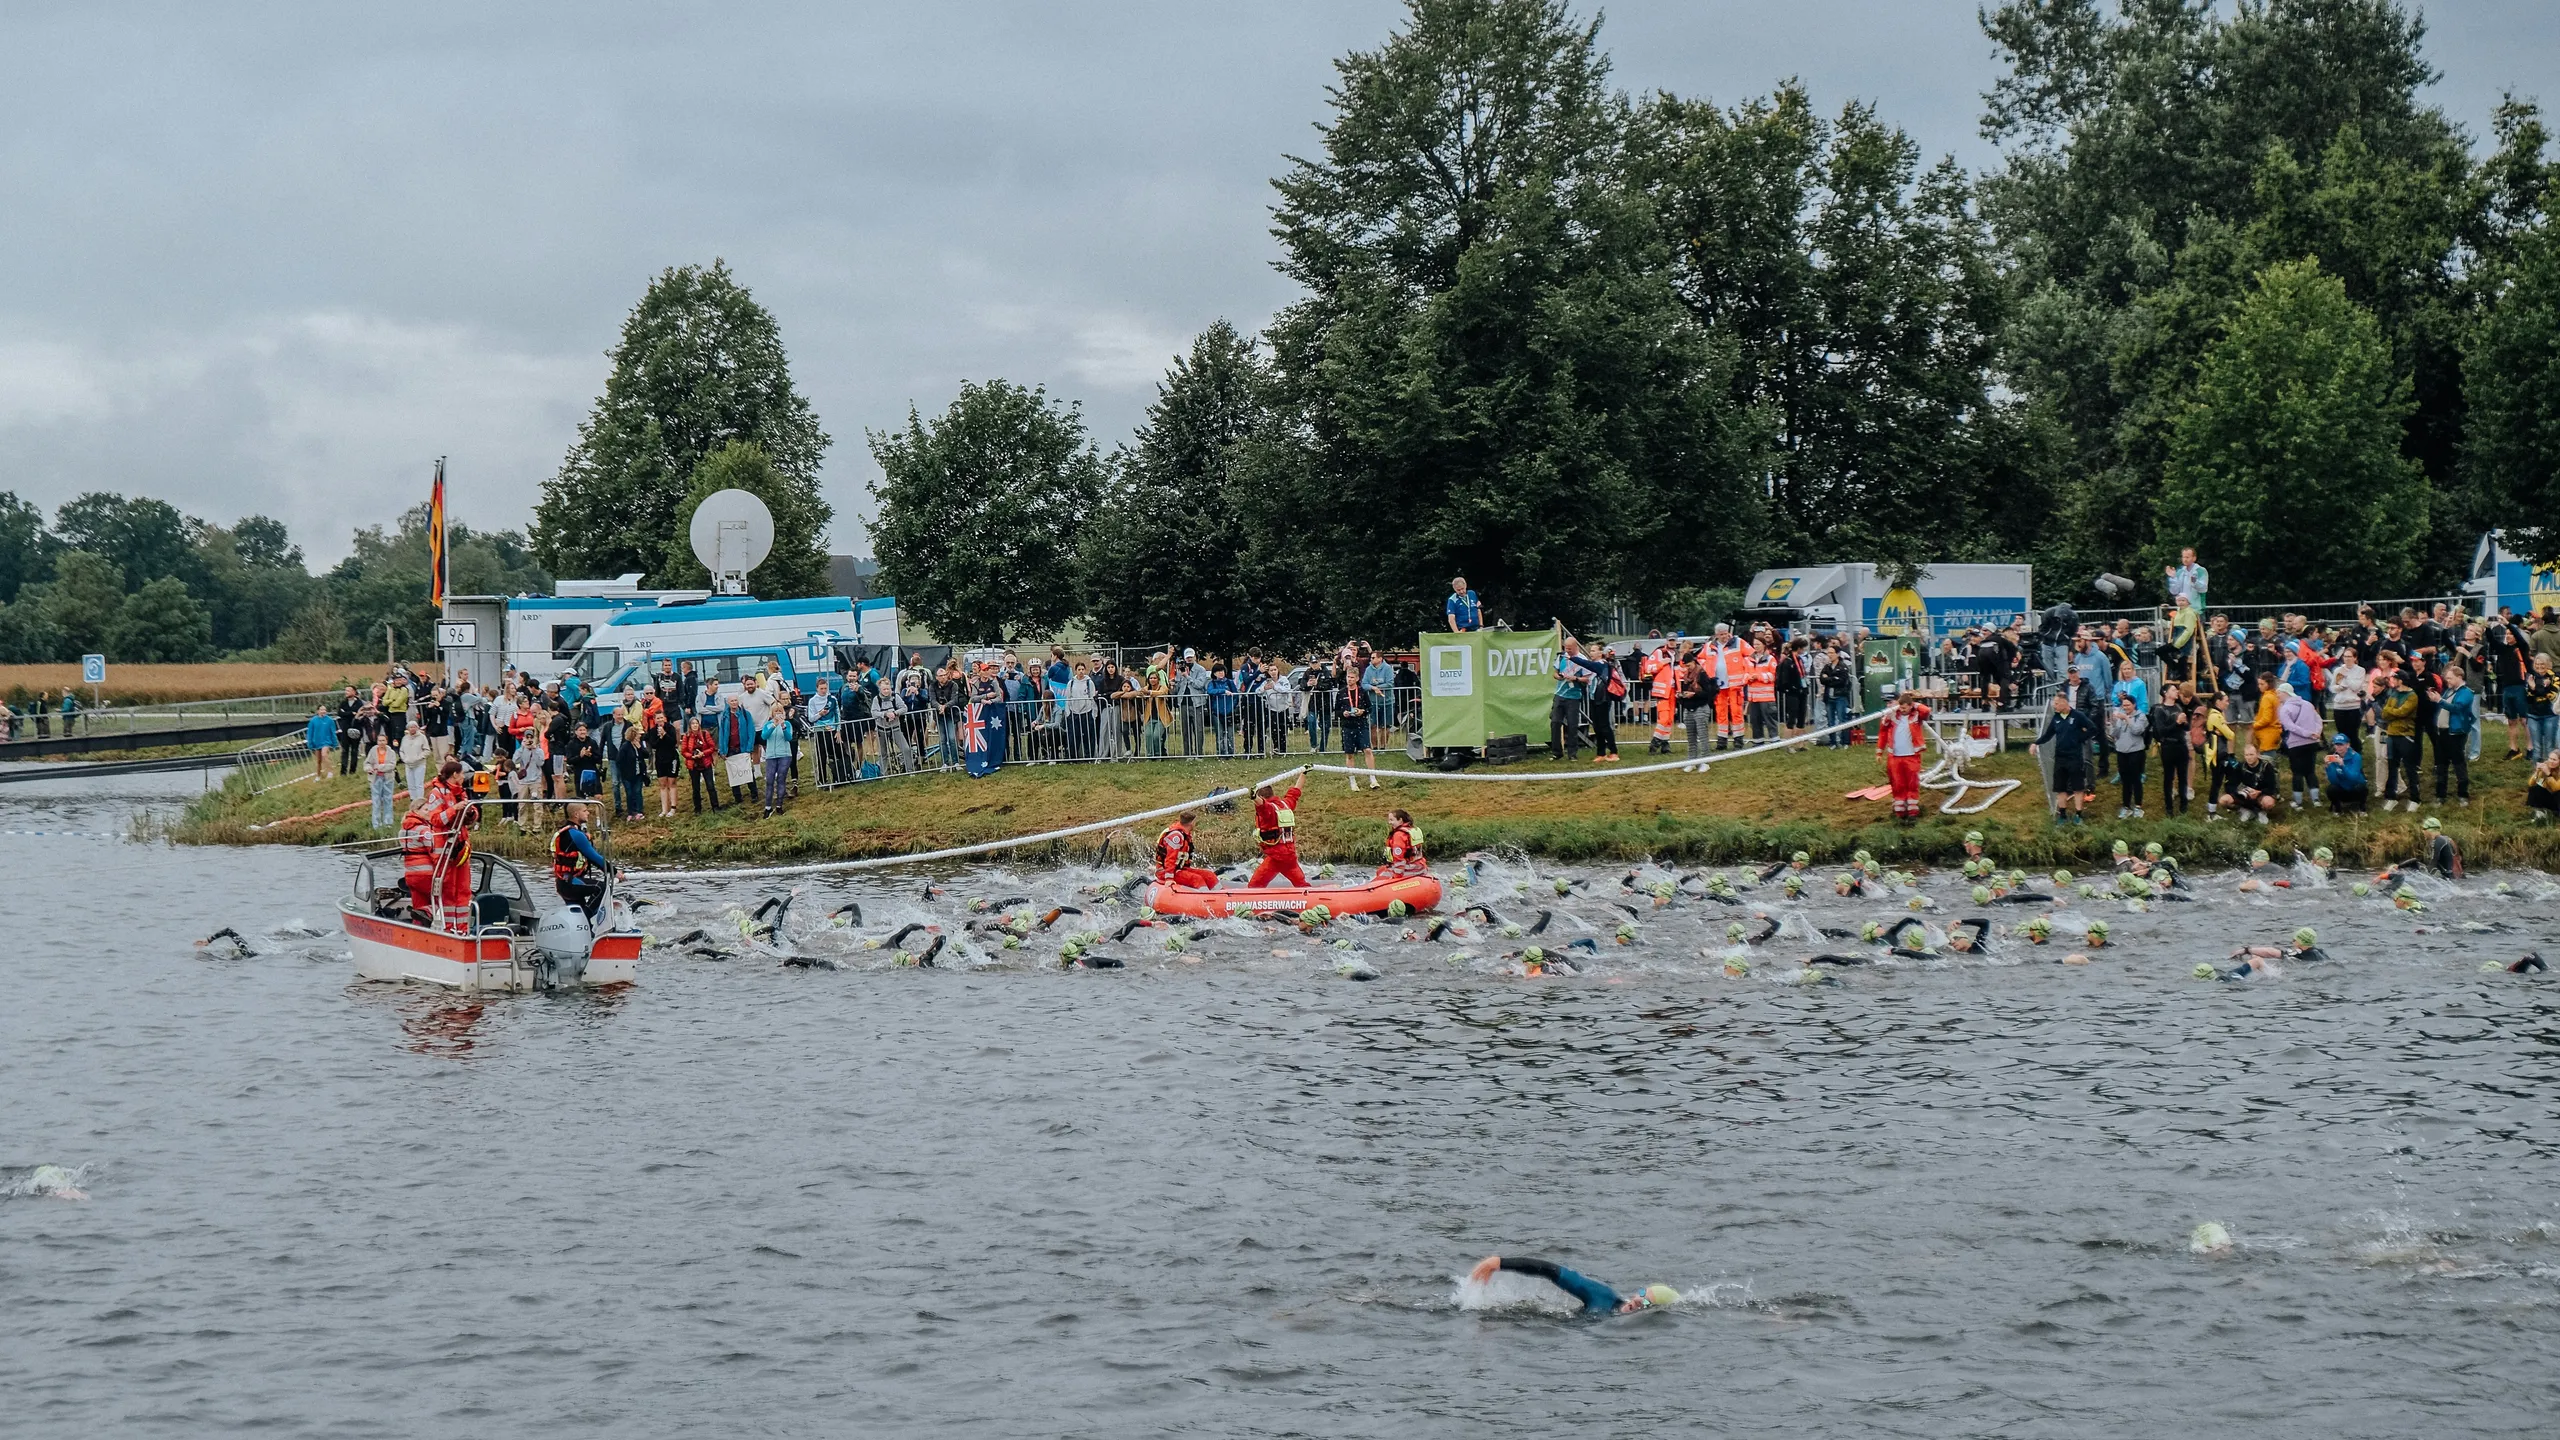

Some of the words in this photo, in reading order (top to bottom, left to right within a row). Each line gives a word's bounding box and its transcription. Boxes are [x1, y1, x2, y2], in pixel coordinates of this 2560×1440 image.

[449, 628, 464, 643] 96
[1488, 648, 1553, 677] DATEV
[1244, 900, 1308, 910] WASSERWACHT
